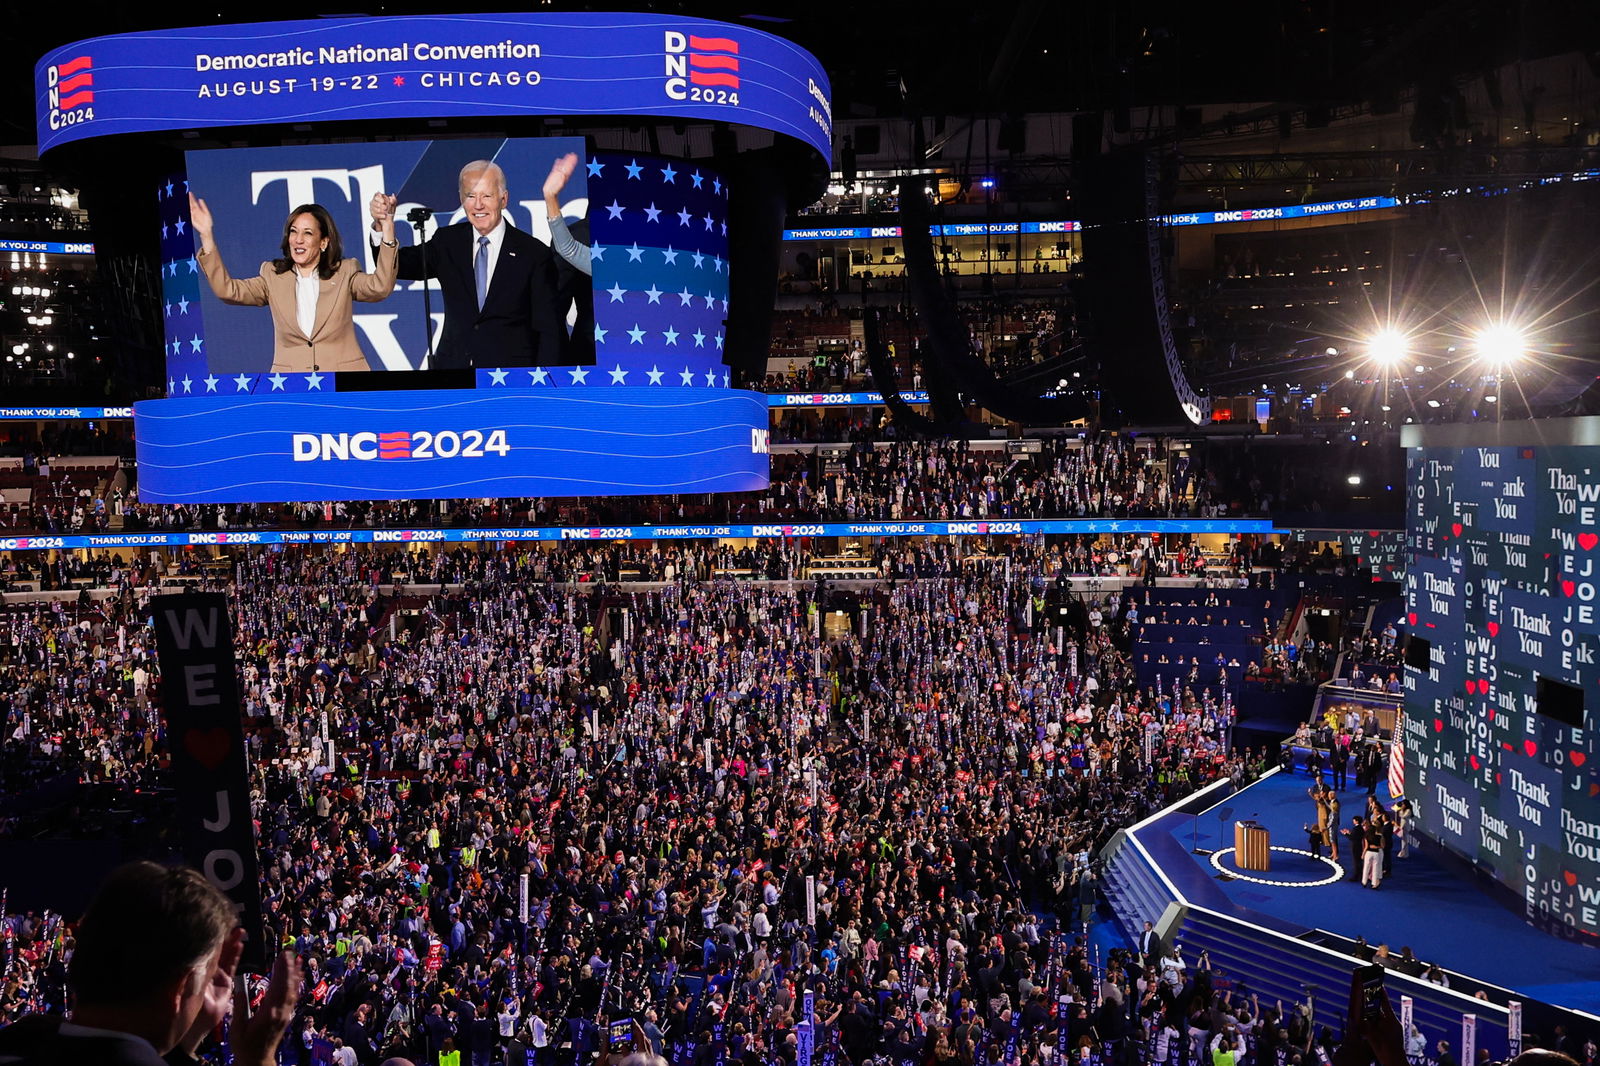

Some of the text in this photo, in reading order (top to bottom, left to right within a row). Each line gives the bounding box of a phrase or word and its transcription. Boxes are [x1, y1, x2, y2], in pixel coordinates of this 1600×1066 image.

[196, 40, 541, 72] Democratic National Convention
[198, 71, 541, 98] AUGUST 19-22 CHICAGO
[690, 87, 739, 106] 2024
[60, 108, 95, 128] 2024
[1214, 208, 1283, 222] DNC 2024
[1303, 203, 1335, 213] THANK
[1358, 199, 1377, 208] JOE
[1039, 222, 1065, 232] DNC
[1172, 215, 1190, 224] JOE
[871, 228, 897, 237] DNC
[64, 244, 92, 253] DNC
[786, 394, 851, 404] DNC 2024
[0, 408, 34, 416] THANK
[35, 408, 55, 416] YOU
[103, 407, 132, 417] DNC
[293, 430, 511, 462] DNC 2024
[1478, 447, 1500, 469] You
[1548, 467, 1577, 491] Tha
[1494, 498, 1517, 520] You
[188, 533, 257, 543] DNC 2024
[373, 531, 443, 541] DNC 2024
[500, 530, 520, 538] YOU
[522, 530, 540, 538] JOE
[600, 528, 632, 538] 2024
[657, 528, 689, 536] THANK
[752, 525, 825, 536] DNC 2024
[849, 525, 883, 533] THANK
[884, 525, 905, 533] YOU
[948, 523, 1022, 534] DNC 2024
[28, 537, 64, 548] 2024
[89, 535, 167, 545] THANK YOU JOE
[1504, 545, 1527, 568] You
[1423, 572, 1456, 597] Thank
[1429, 593, 1449, 616] You
[1510, 606, 1551, 636] Thank
[1518, 631, 1543, 658] You
[164, 607, 220, 706] WE
[1509, 768, 1550, 808] Thank
[1435, 783, 1470, 819] Thank
[1516, 794, 1542, 827] You
[1441, 806, 1463, 836] You
[1480, 806, 1509, 839] hank
[1480, 825, 1502, 857] You
